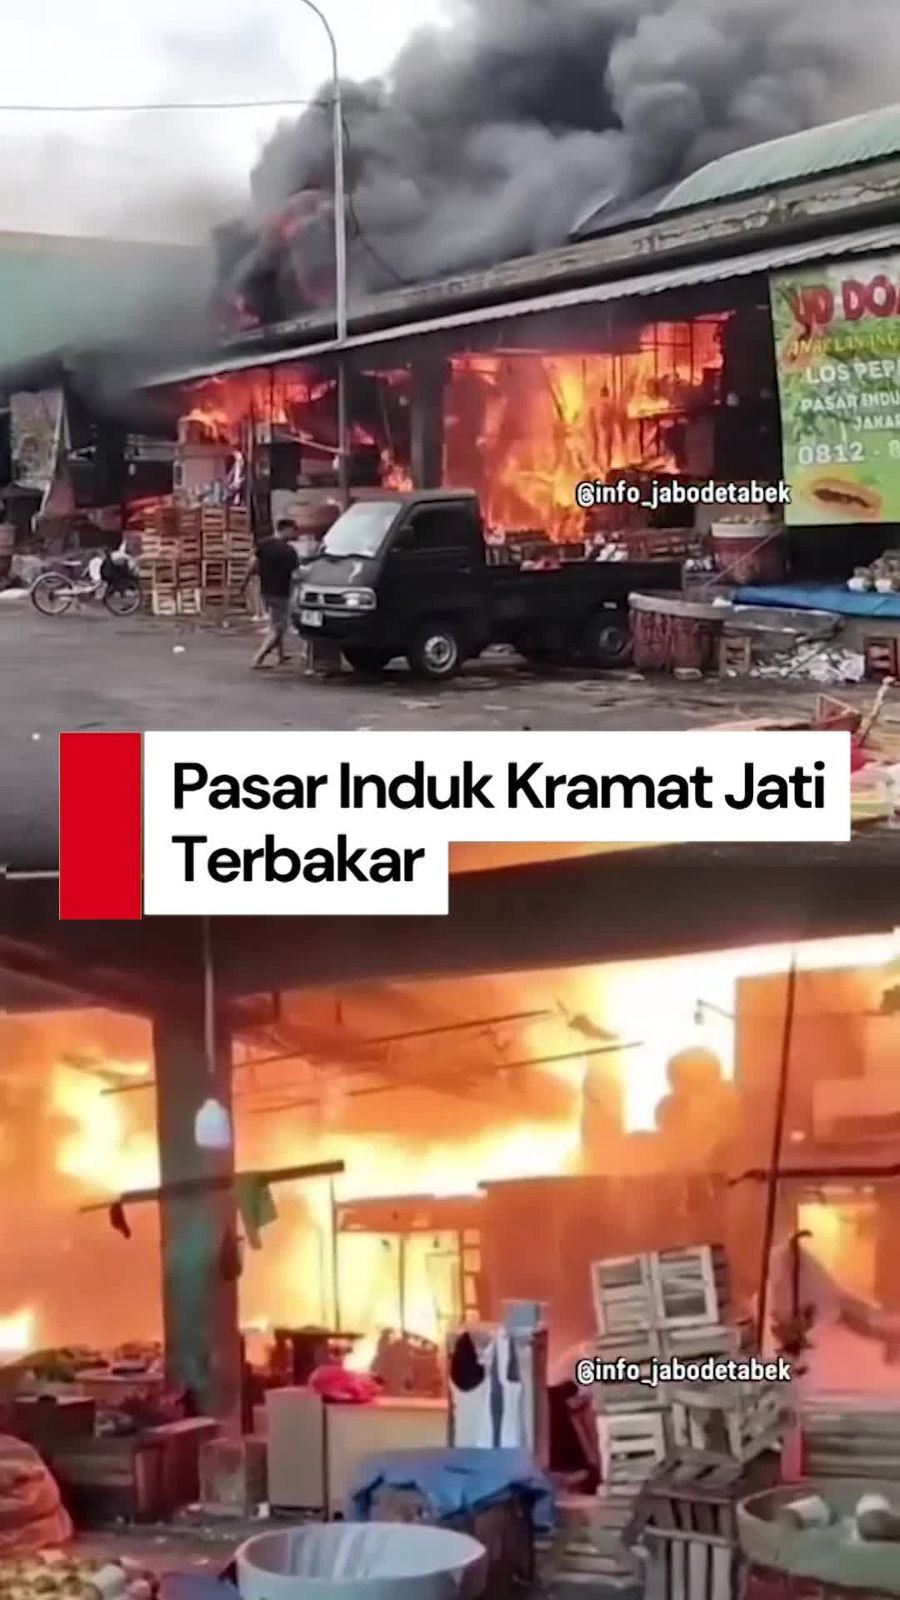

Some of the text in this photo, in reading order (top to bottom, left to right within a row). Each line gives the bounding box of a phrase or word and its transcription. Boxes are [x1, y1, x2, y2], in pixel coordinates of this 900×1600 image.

[806, 359, 900, 384] LOS PEP
[800, 394, 858, 412] PASAR
[798, 441, 865, 464] 0812
